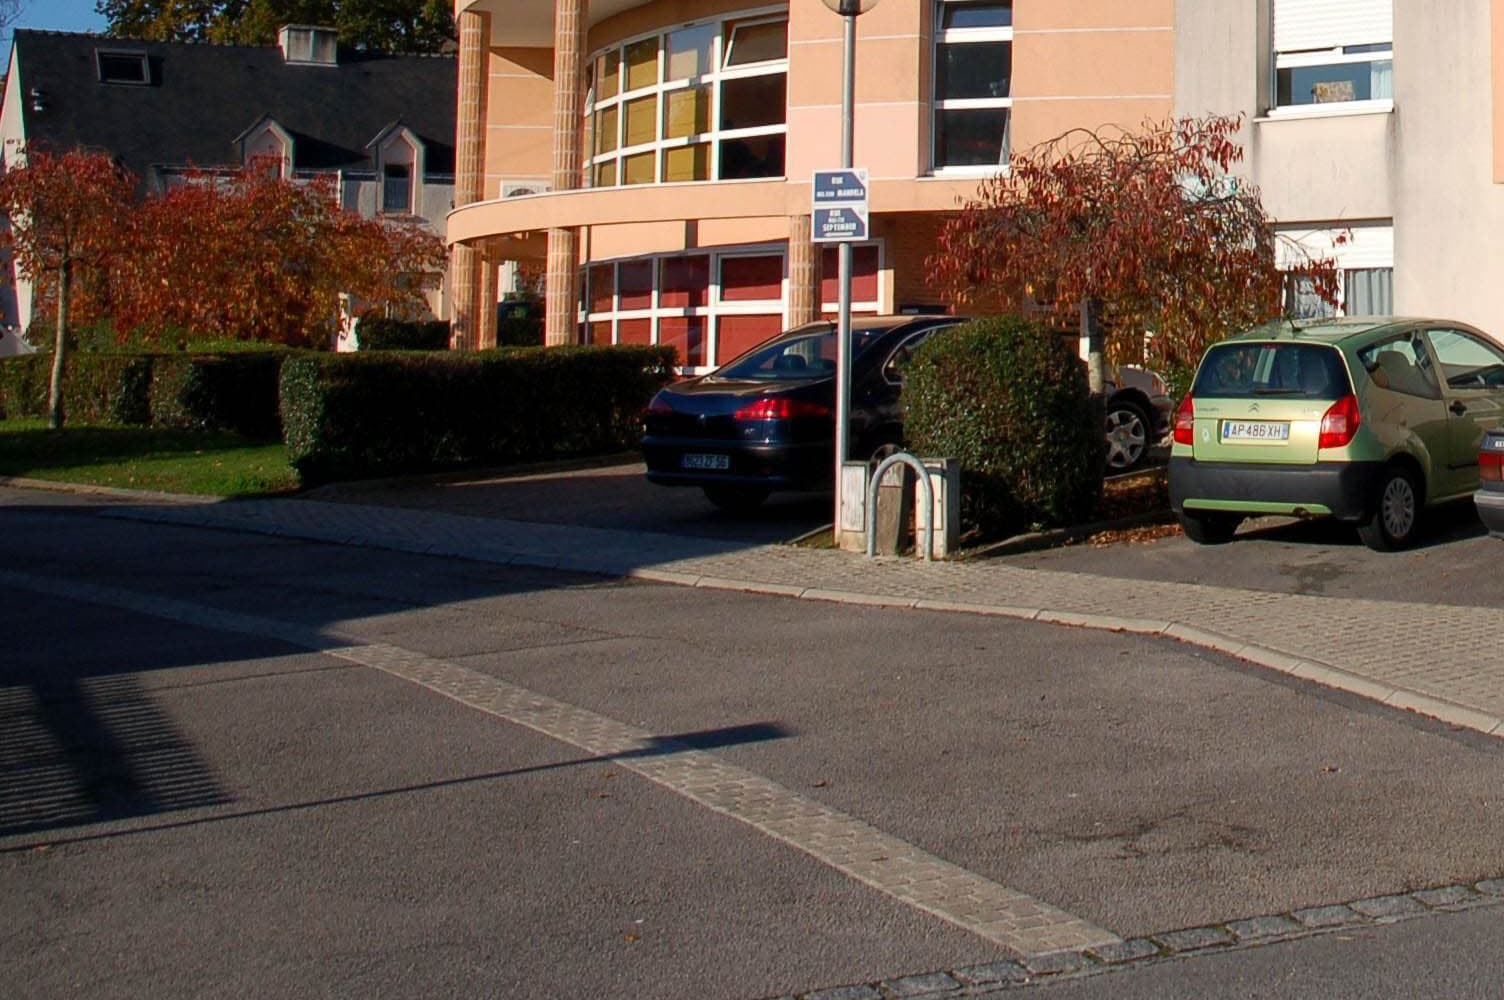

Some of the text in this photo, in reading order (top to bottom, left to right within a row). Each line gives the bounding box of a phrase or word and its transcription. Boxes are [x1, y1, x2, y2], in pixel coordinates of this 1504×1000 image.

[837, 188, 864, 197] MANDELA
[1231, 424, 1281, 437] AP 486 XH
